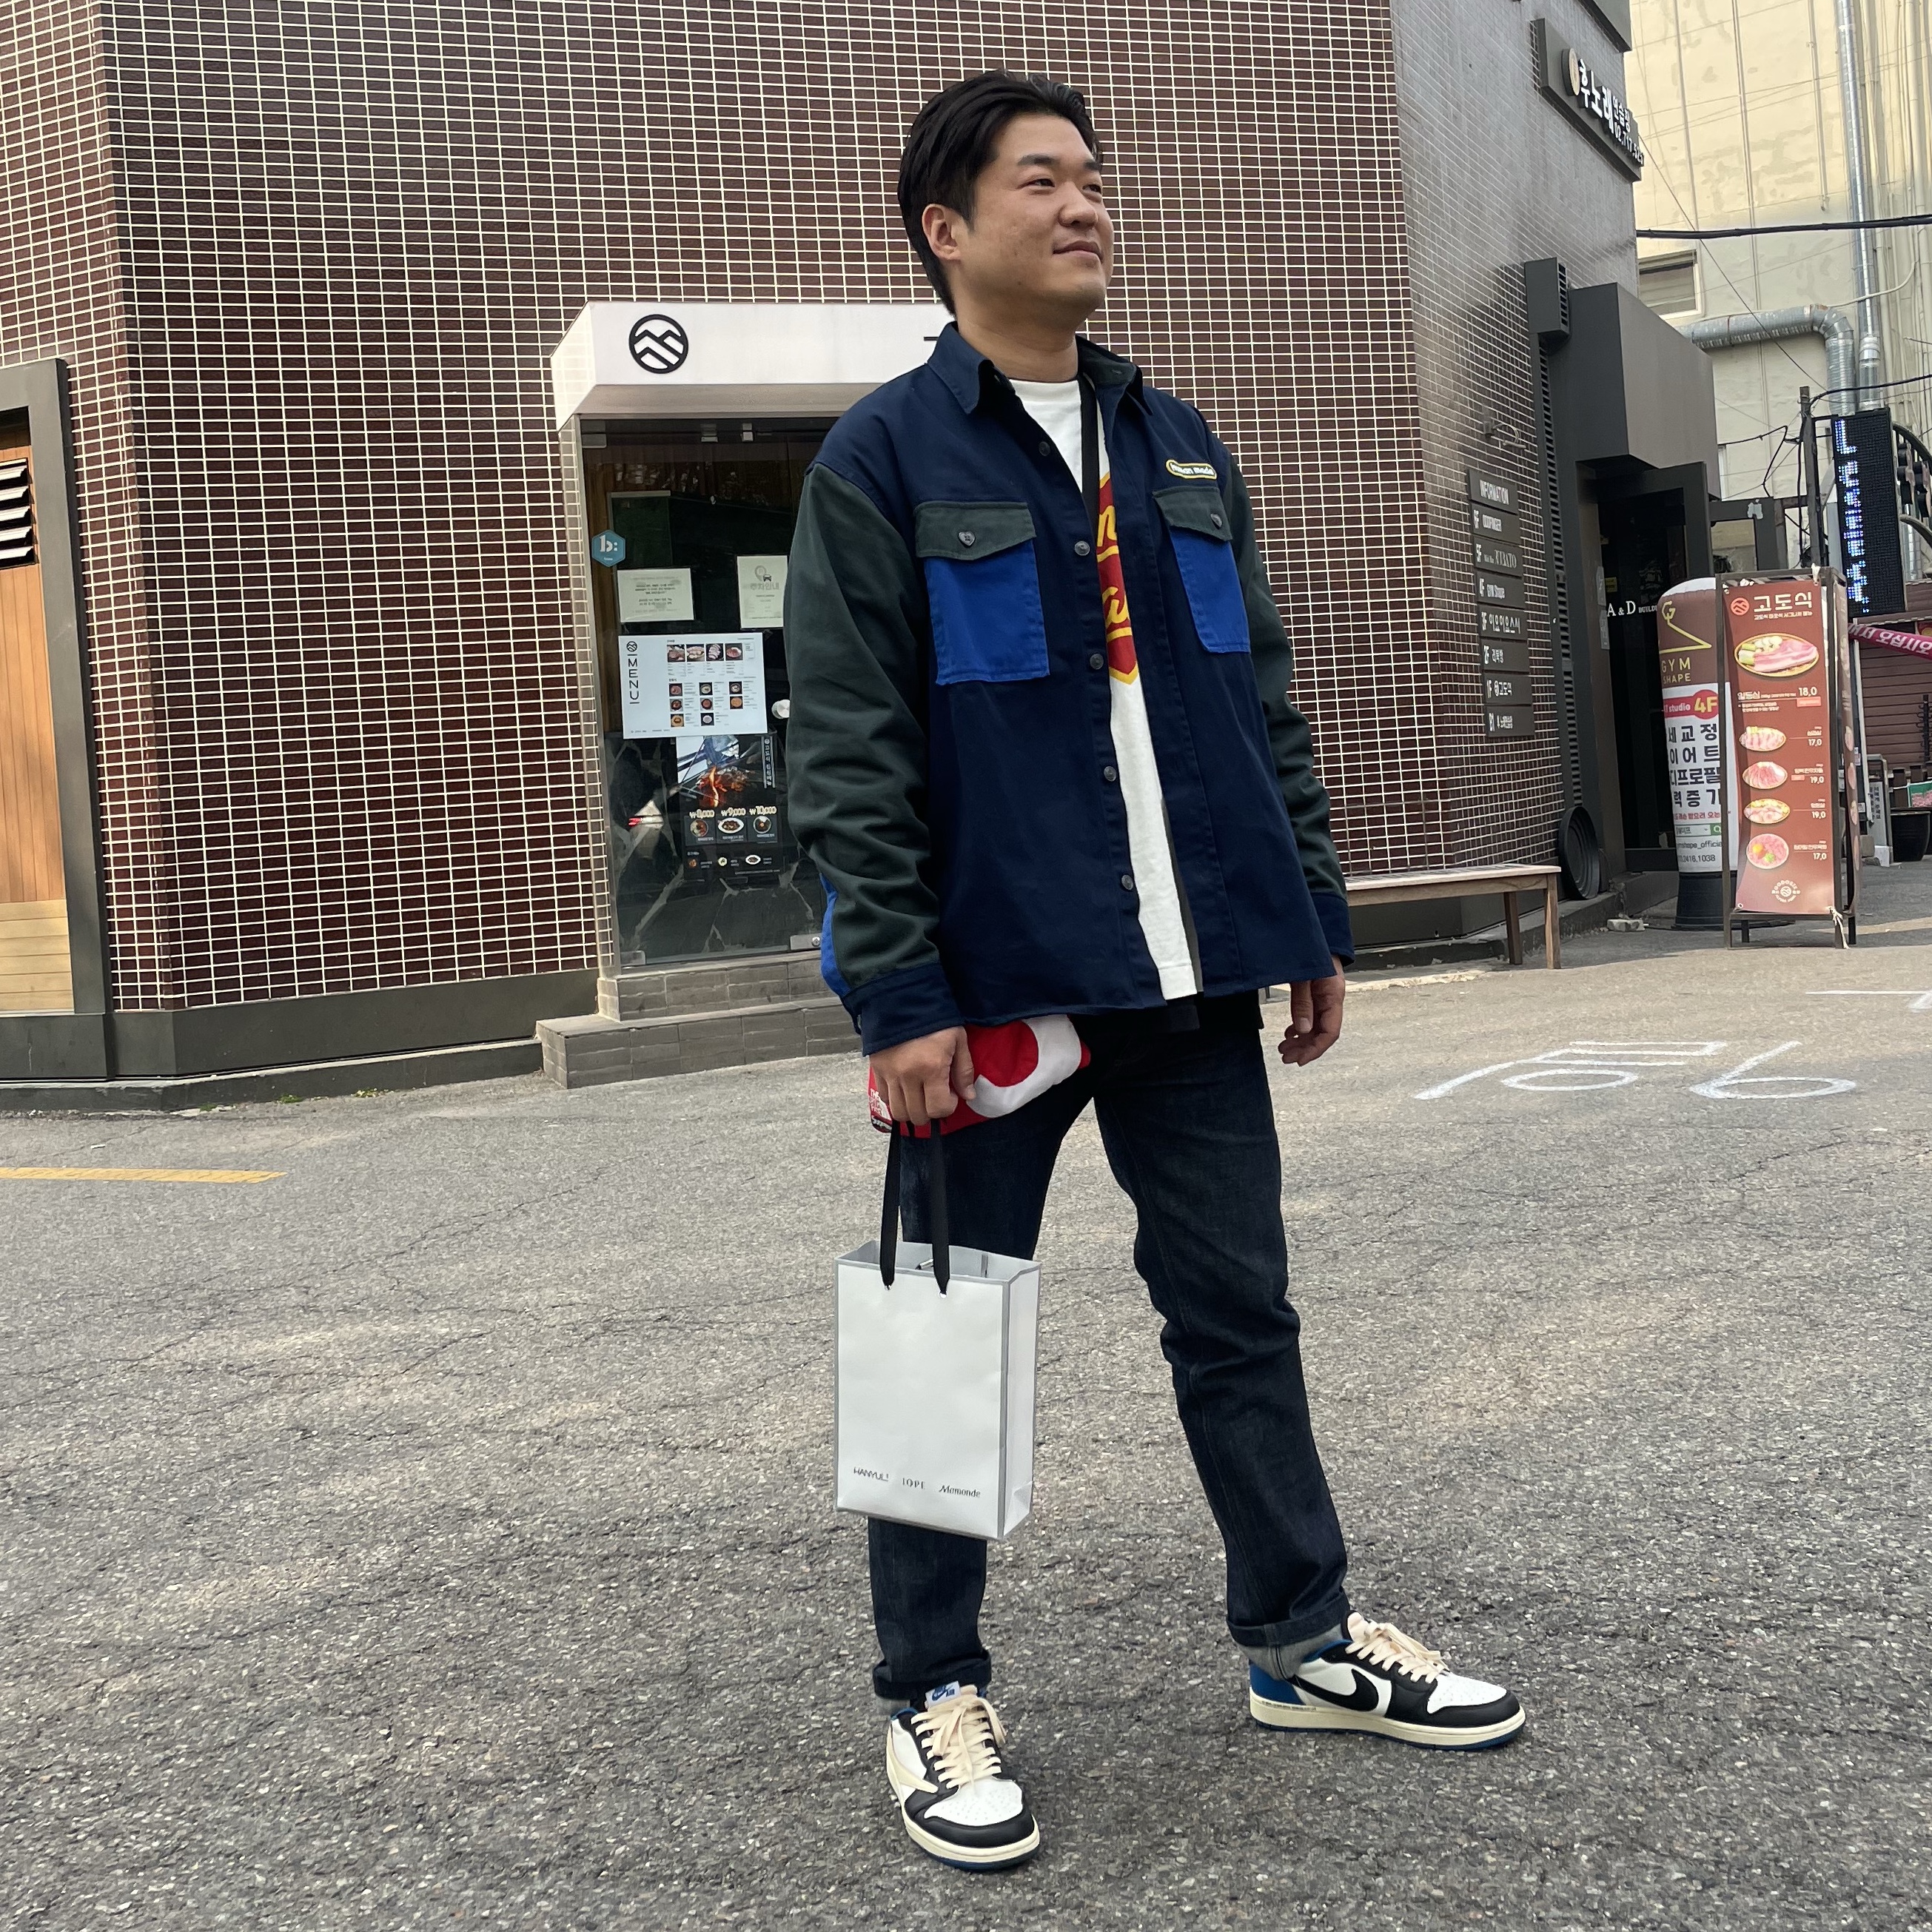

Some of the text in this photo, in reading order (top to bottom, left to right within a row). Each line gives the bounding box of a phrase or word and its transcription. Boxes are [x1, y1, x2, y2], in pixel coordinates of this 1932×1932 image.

[1606, 603, 1617, 617] A
[1618, 607, 1624, 616] &
[1626, 600, 1637, 615] D
[1754, 591, 1813, 613] 고도식
[1876, 631, 1932, 655] 오십시오
[1661, 657, 1691, 673] GYM
[628, 658, 640, 700] MENU
[1663, 672, 1691, 685] SHAPE
[1798, 686, 1817, 697] 18,0
[1668, 702, 1691, 713] studio
[1694, 696, 1718, 713] 4F
[1808, 738, 1822, 747] 17,0
[1810, 776, 1825, 784] 19,0
[1811, 811, 1826, 819] 19,0
[1813, 853, 1827, 861] 17,0
[938, 1484, 981, 1498] Mamonde
